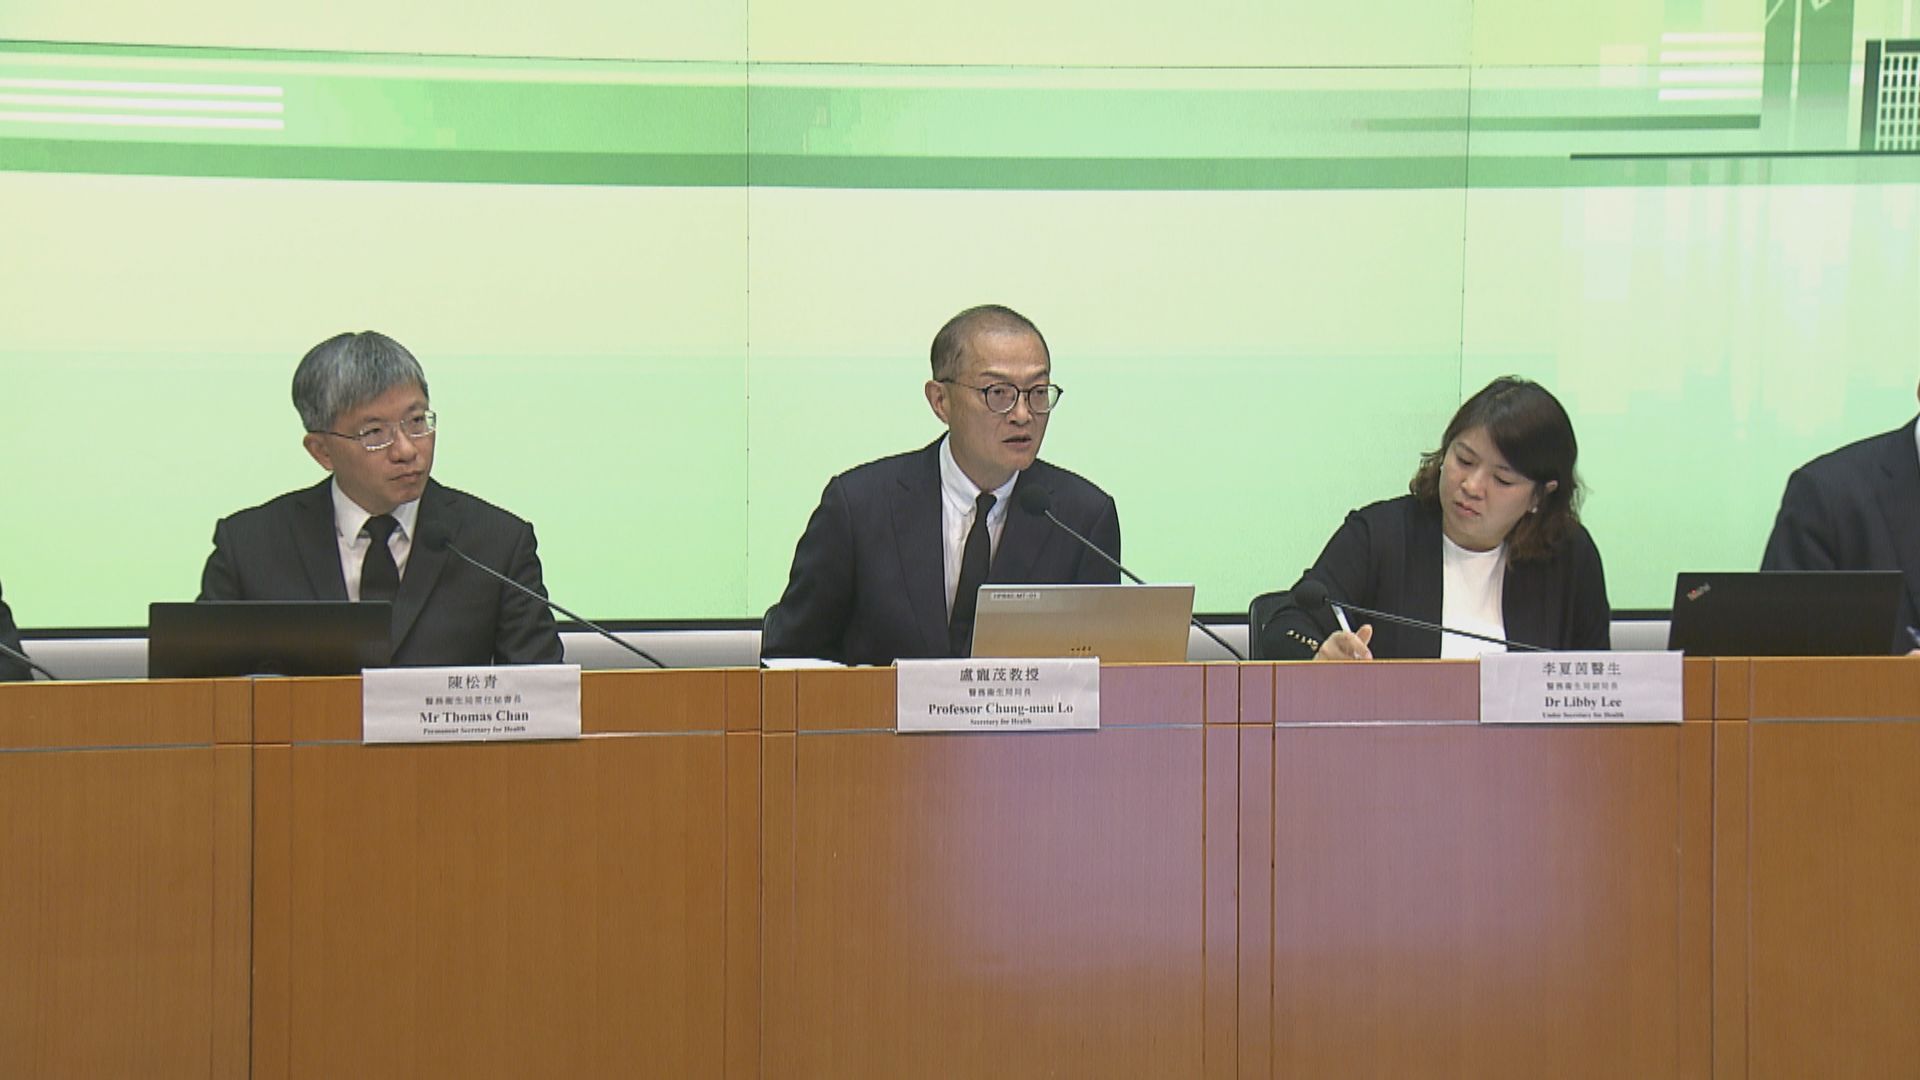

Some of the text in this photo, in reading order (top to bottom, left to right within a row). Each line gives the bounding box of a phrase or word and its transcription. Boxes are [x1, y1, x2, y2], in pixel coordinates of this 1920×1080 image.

[447, 675, 499, 690] 陳松青
[928, 702, 1073, 716] Professor Chung-mau Lo
[1544, 696, 1622, 710] Dr Libby Lee
[419, 709, 529, 724] Mr Thomas Chan
[492, 725, 502, 733] for
[504, 725, 526, 733] Health
